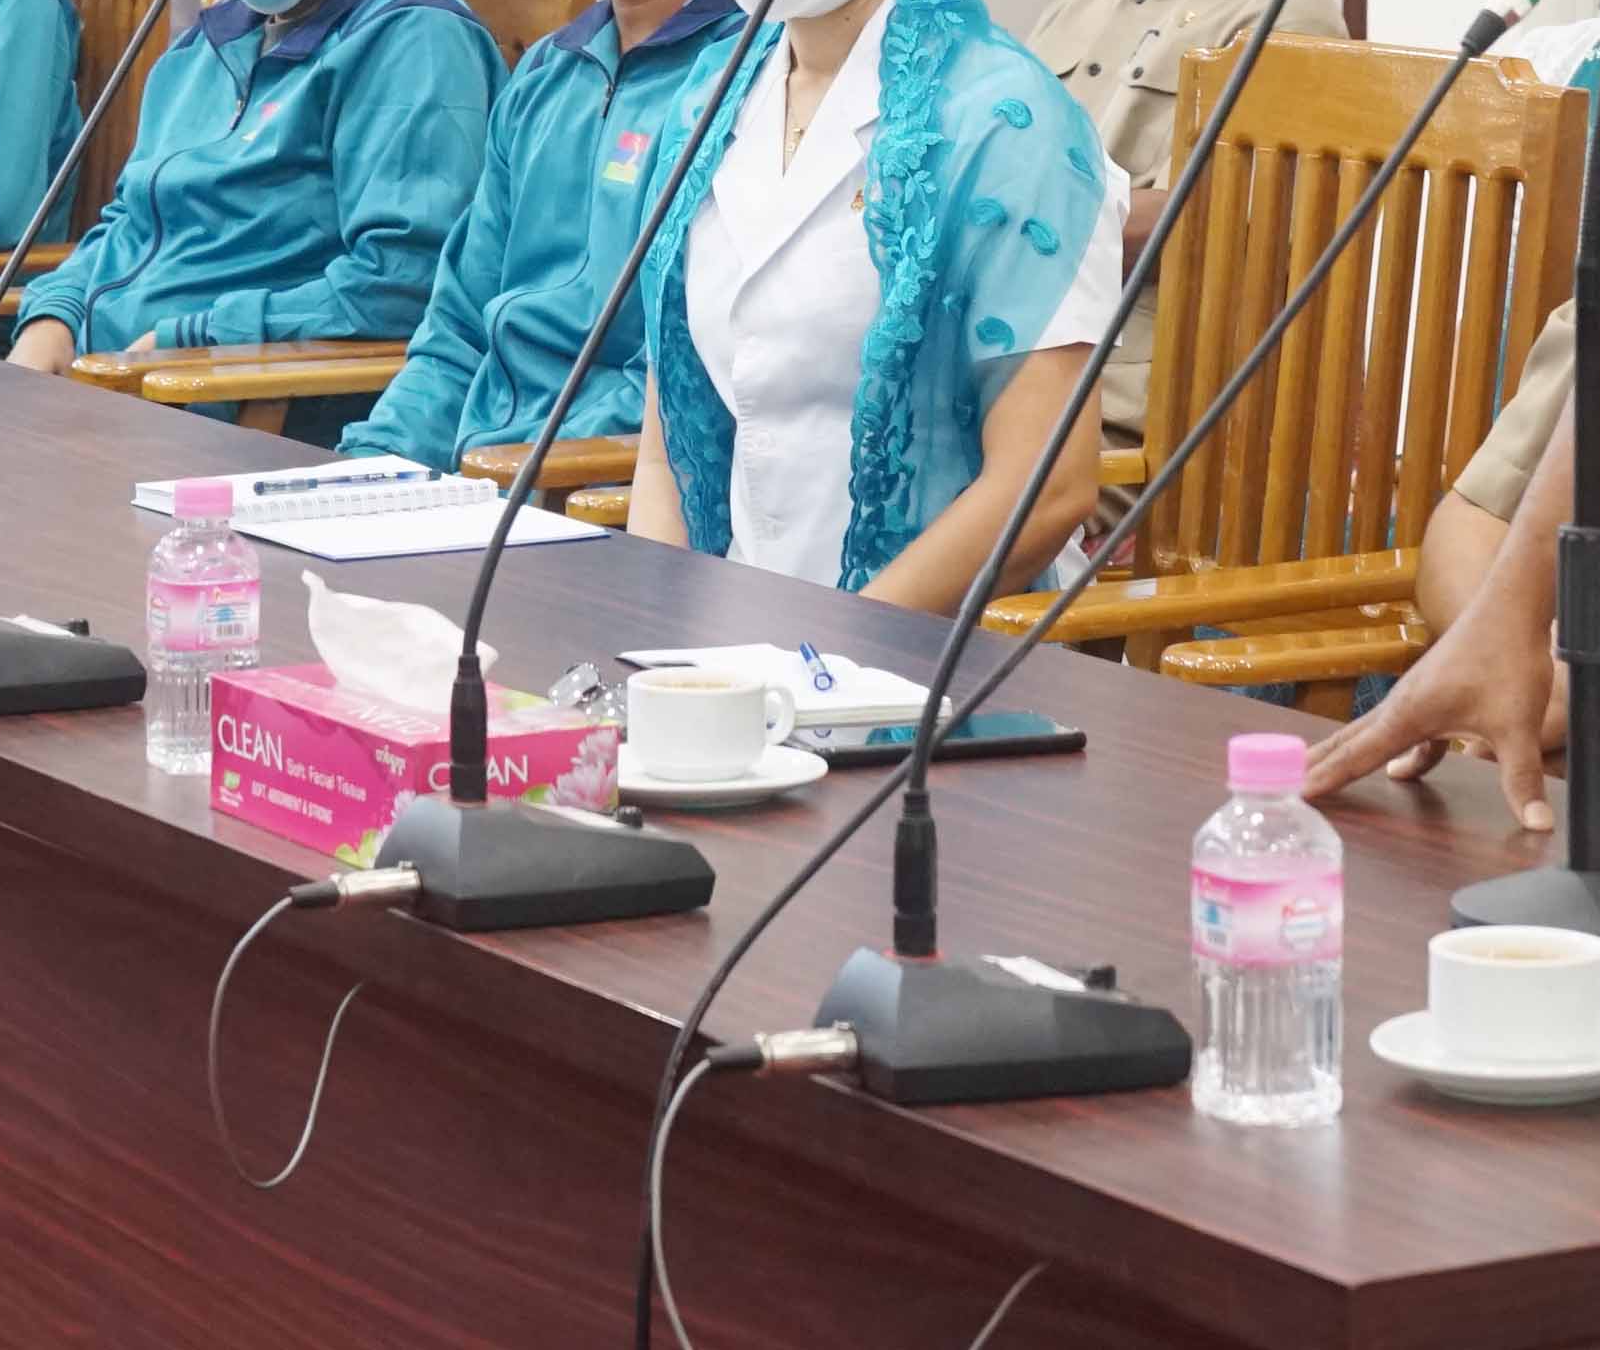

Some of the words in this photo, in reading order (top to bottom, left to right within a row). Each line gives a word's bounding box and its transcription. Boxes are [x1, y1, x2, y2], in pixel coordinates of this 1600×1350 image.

[217, 713, 284, 772] CLEAN
[286, 757, 307, 781] Soft
[307, 765, 336, 792] Facial
[336, 774, 367, 803] Tissue
[427, 754, 530, 792] CAN
